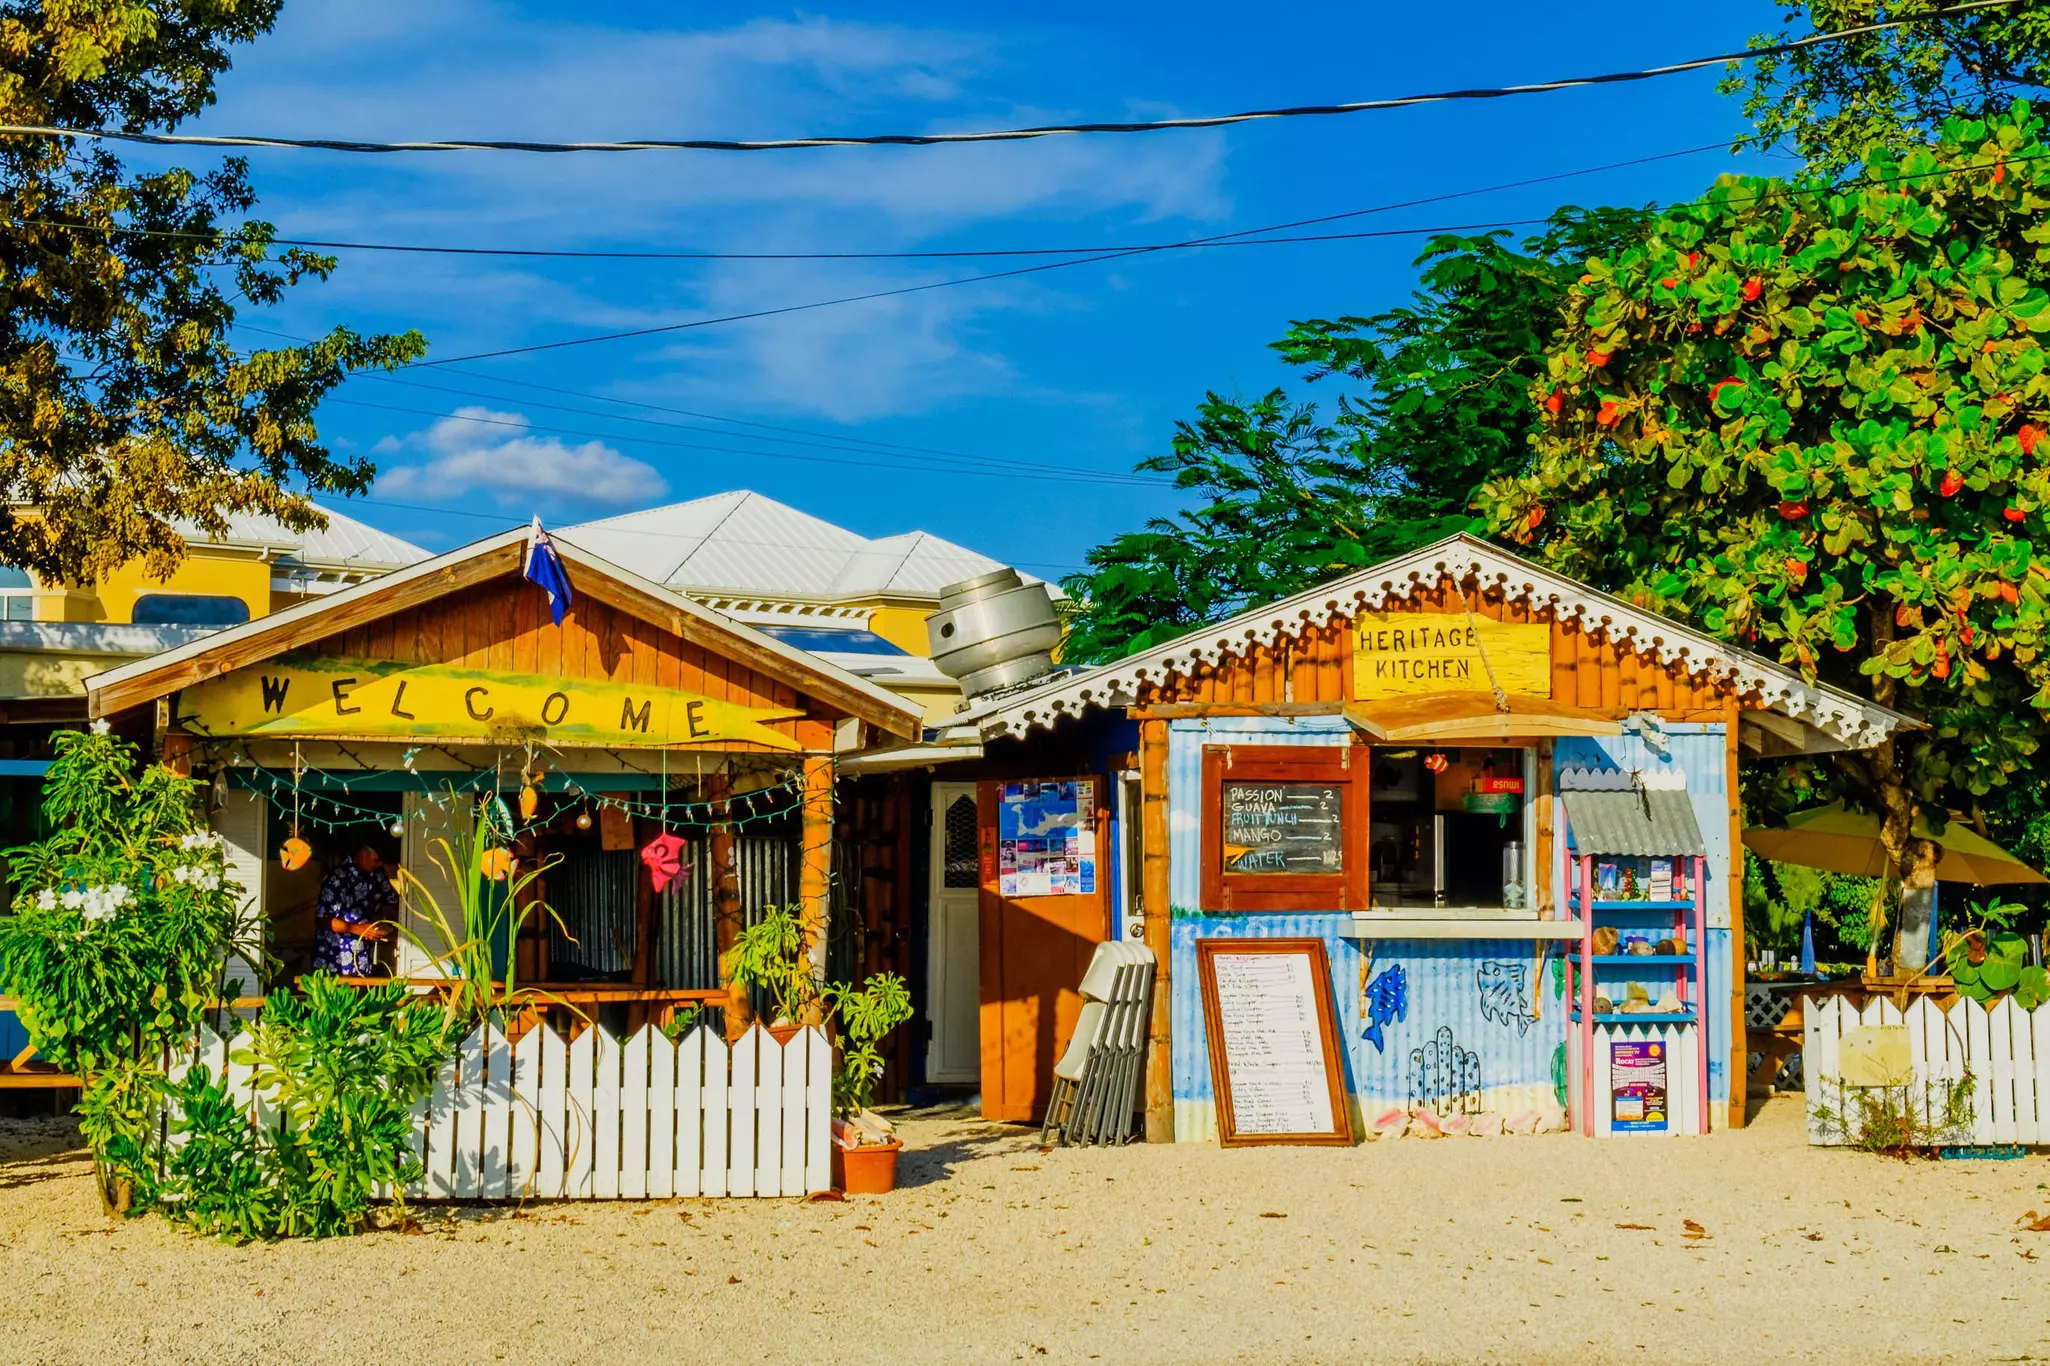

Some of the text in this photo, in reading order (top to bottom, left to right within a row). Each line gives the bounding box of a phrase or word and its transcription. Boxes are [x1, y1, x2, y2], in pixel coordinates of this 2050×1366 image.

[1360, 626, 1478, 652] HERITAGE
[1376, 659, 1469, 679] KITCHEN
[261, 675, 712, 738] WELCOME
[1230, 787, 1334, 803] PASSION 2
[1231, 801, 1329, 814] GUAVA 2
[1231, 812, 1262, 827] FRUIT
[1332, 814, 1340, 823] 2
[1233, 828, 1332, 843] MANGO 2
[1237, 851, 1286, 870] WATER
